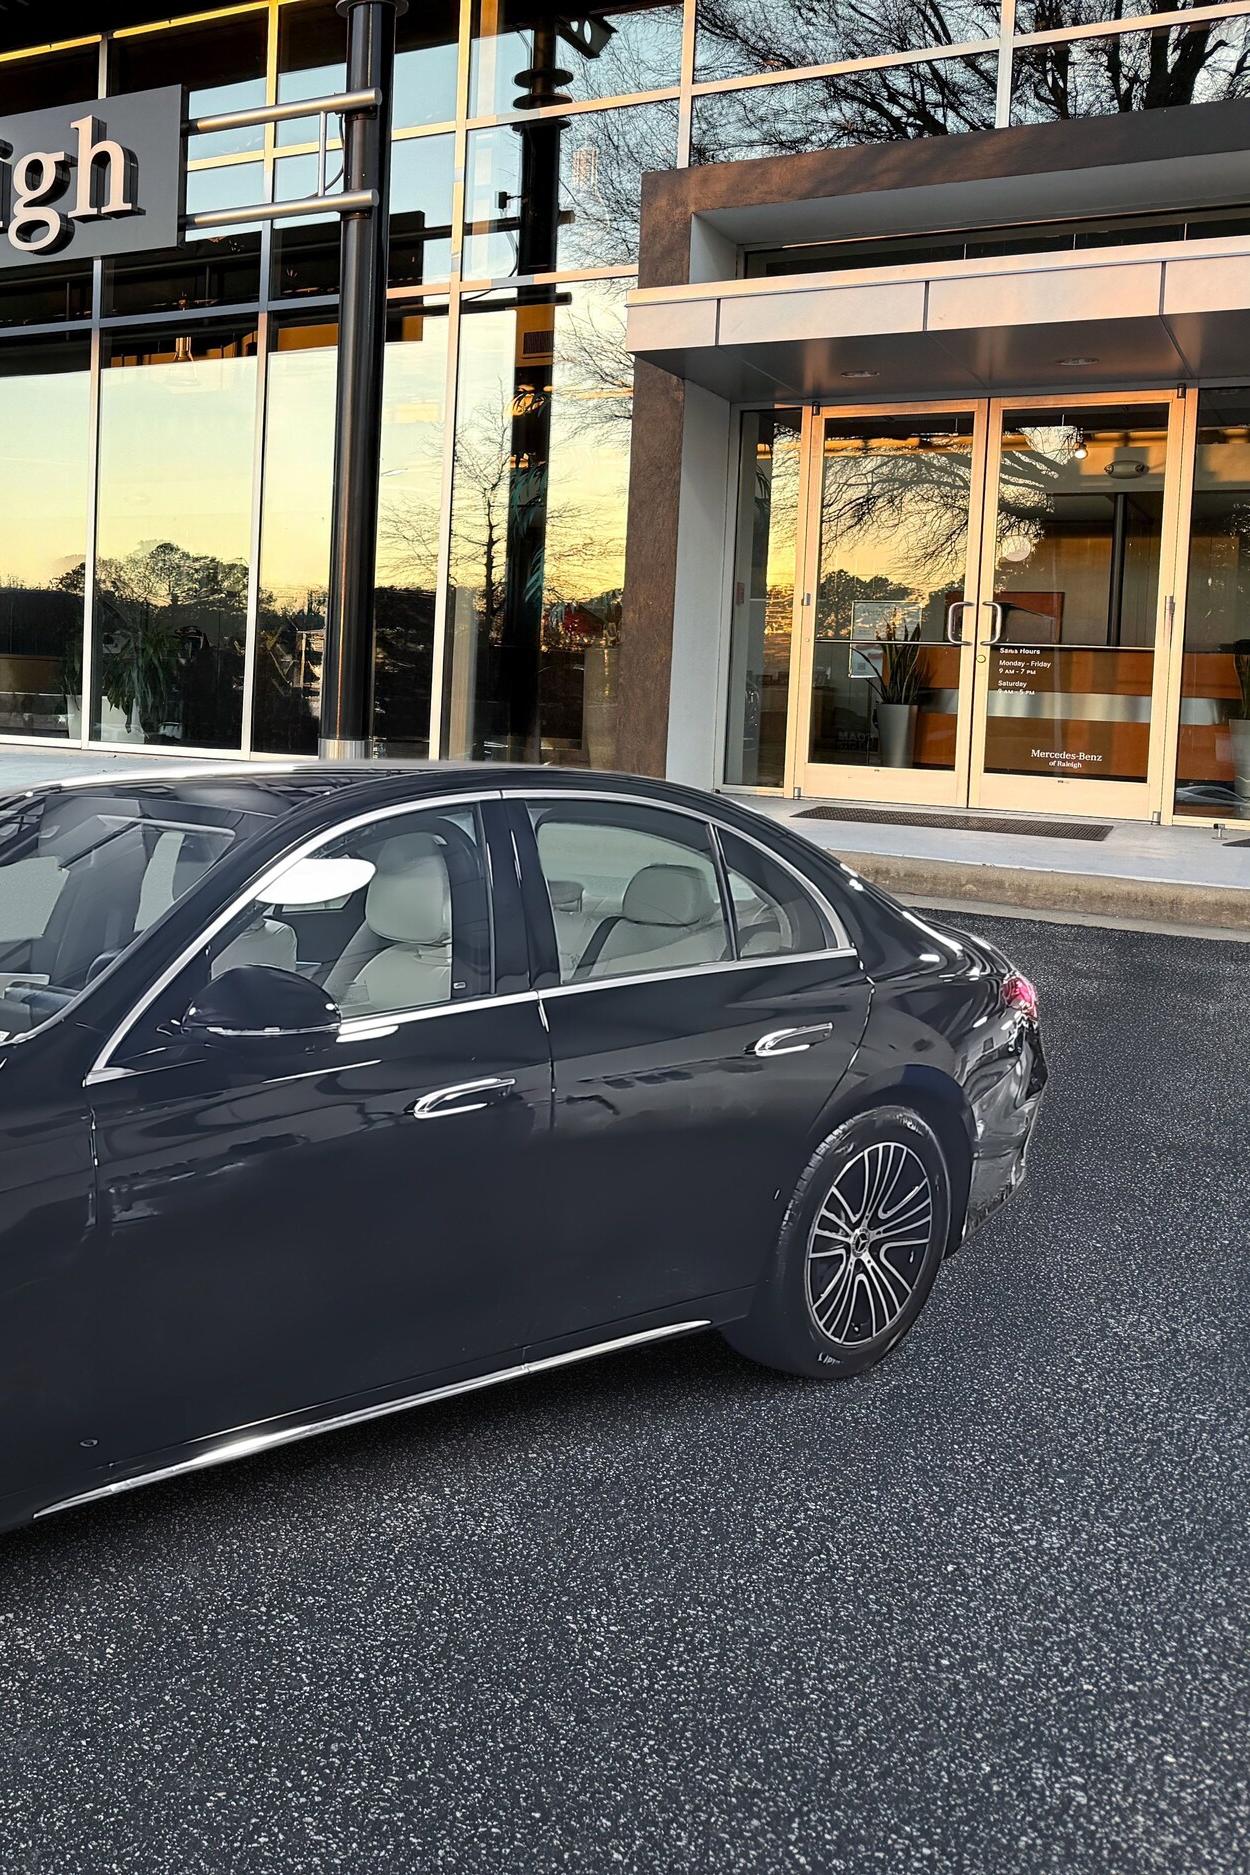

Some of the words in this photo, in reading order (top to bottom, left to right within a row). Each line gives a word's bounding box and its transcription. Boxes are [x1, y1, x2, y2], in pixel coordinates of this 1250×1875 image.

[998, 680, 1027, 688] Saturday
[1031, 749, 1103, 761] Mercedes-Benz
[1057, 761, 1082, 769] Raleigh
